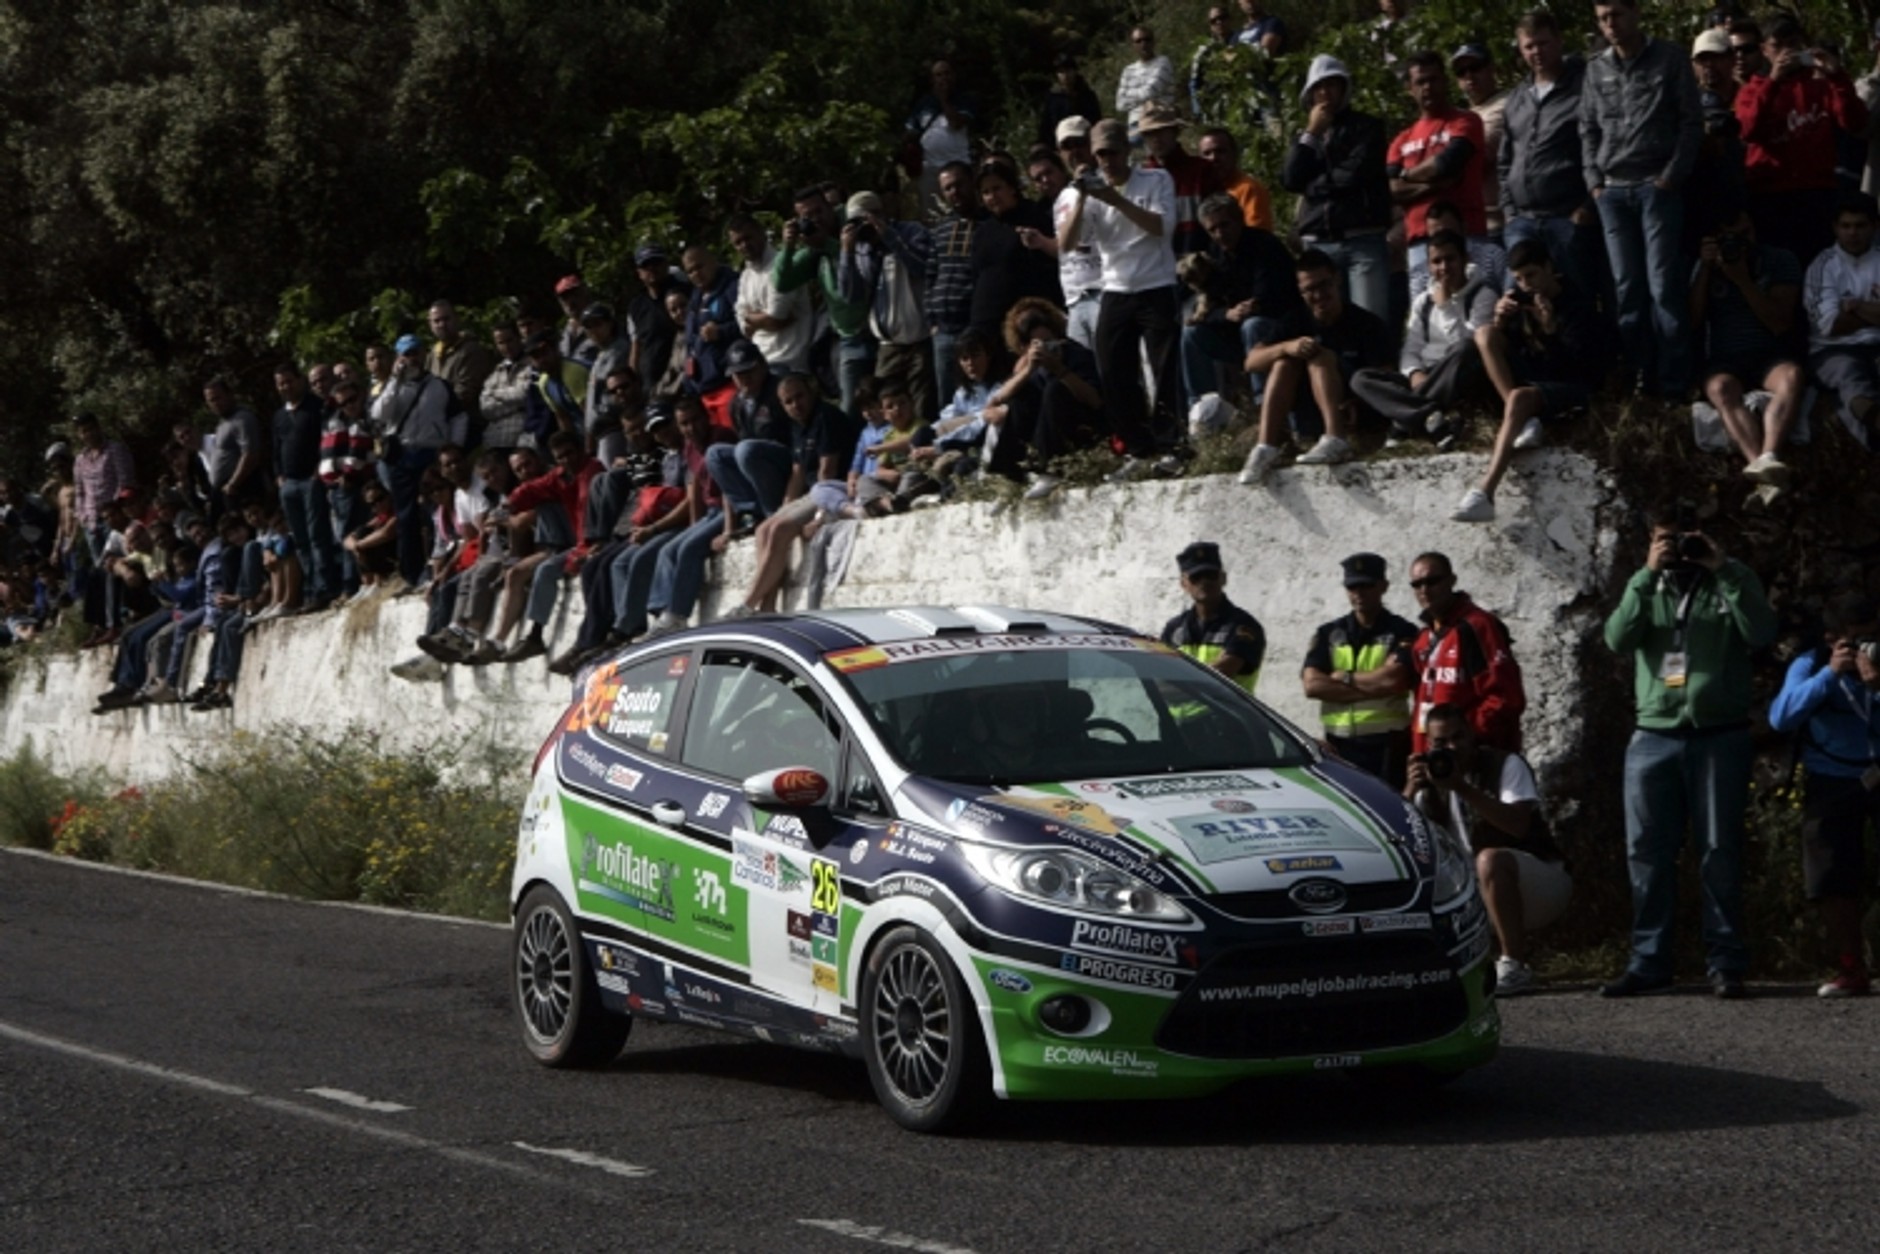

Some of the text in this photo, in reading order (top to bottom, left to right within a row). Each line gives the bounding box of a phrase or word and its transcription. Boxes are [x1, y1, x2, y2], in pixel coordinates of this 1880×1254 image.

[886, 635, 1137, 658] RALLY-IRC.COM
[613, 684, 661, 713] Souto
[782, 771, 819, 788] IRC
[1192, 814, 1329, 838] RIVER
[811, 860, 838, 914] 26
[1079, 958, 1175, 988] PROGRESO
[1200, 969, 1451, 1001] www.nupelglobalracing.com
